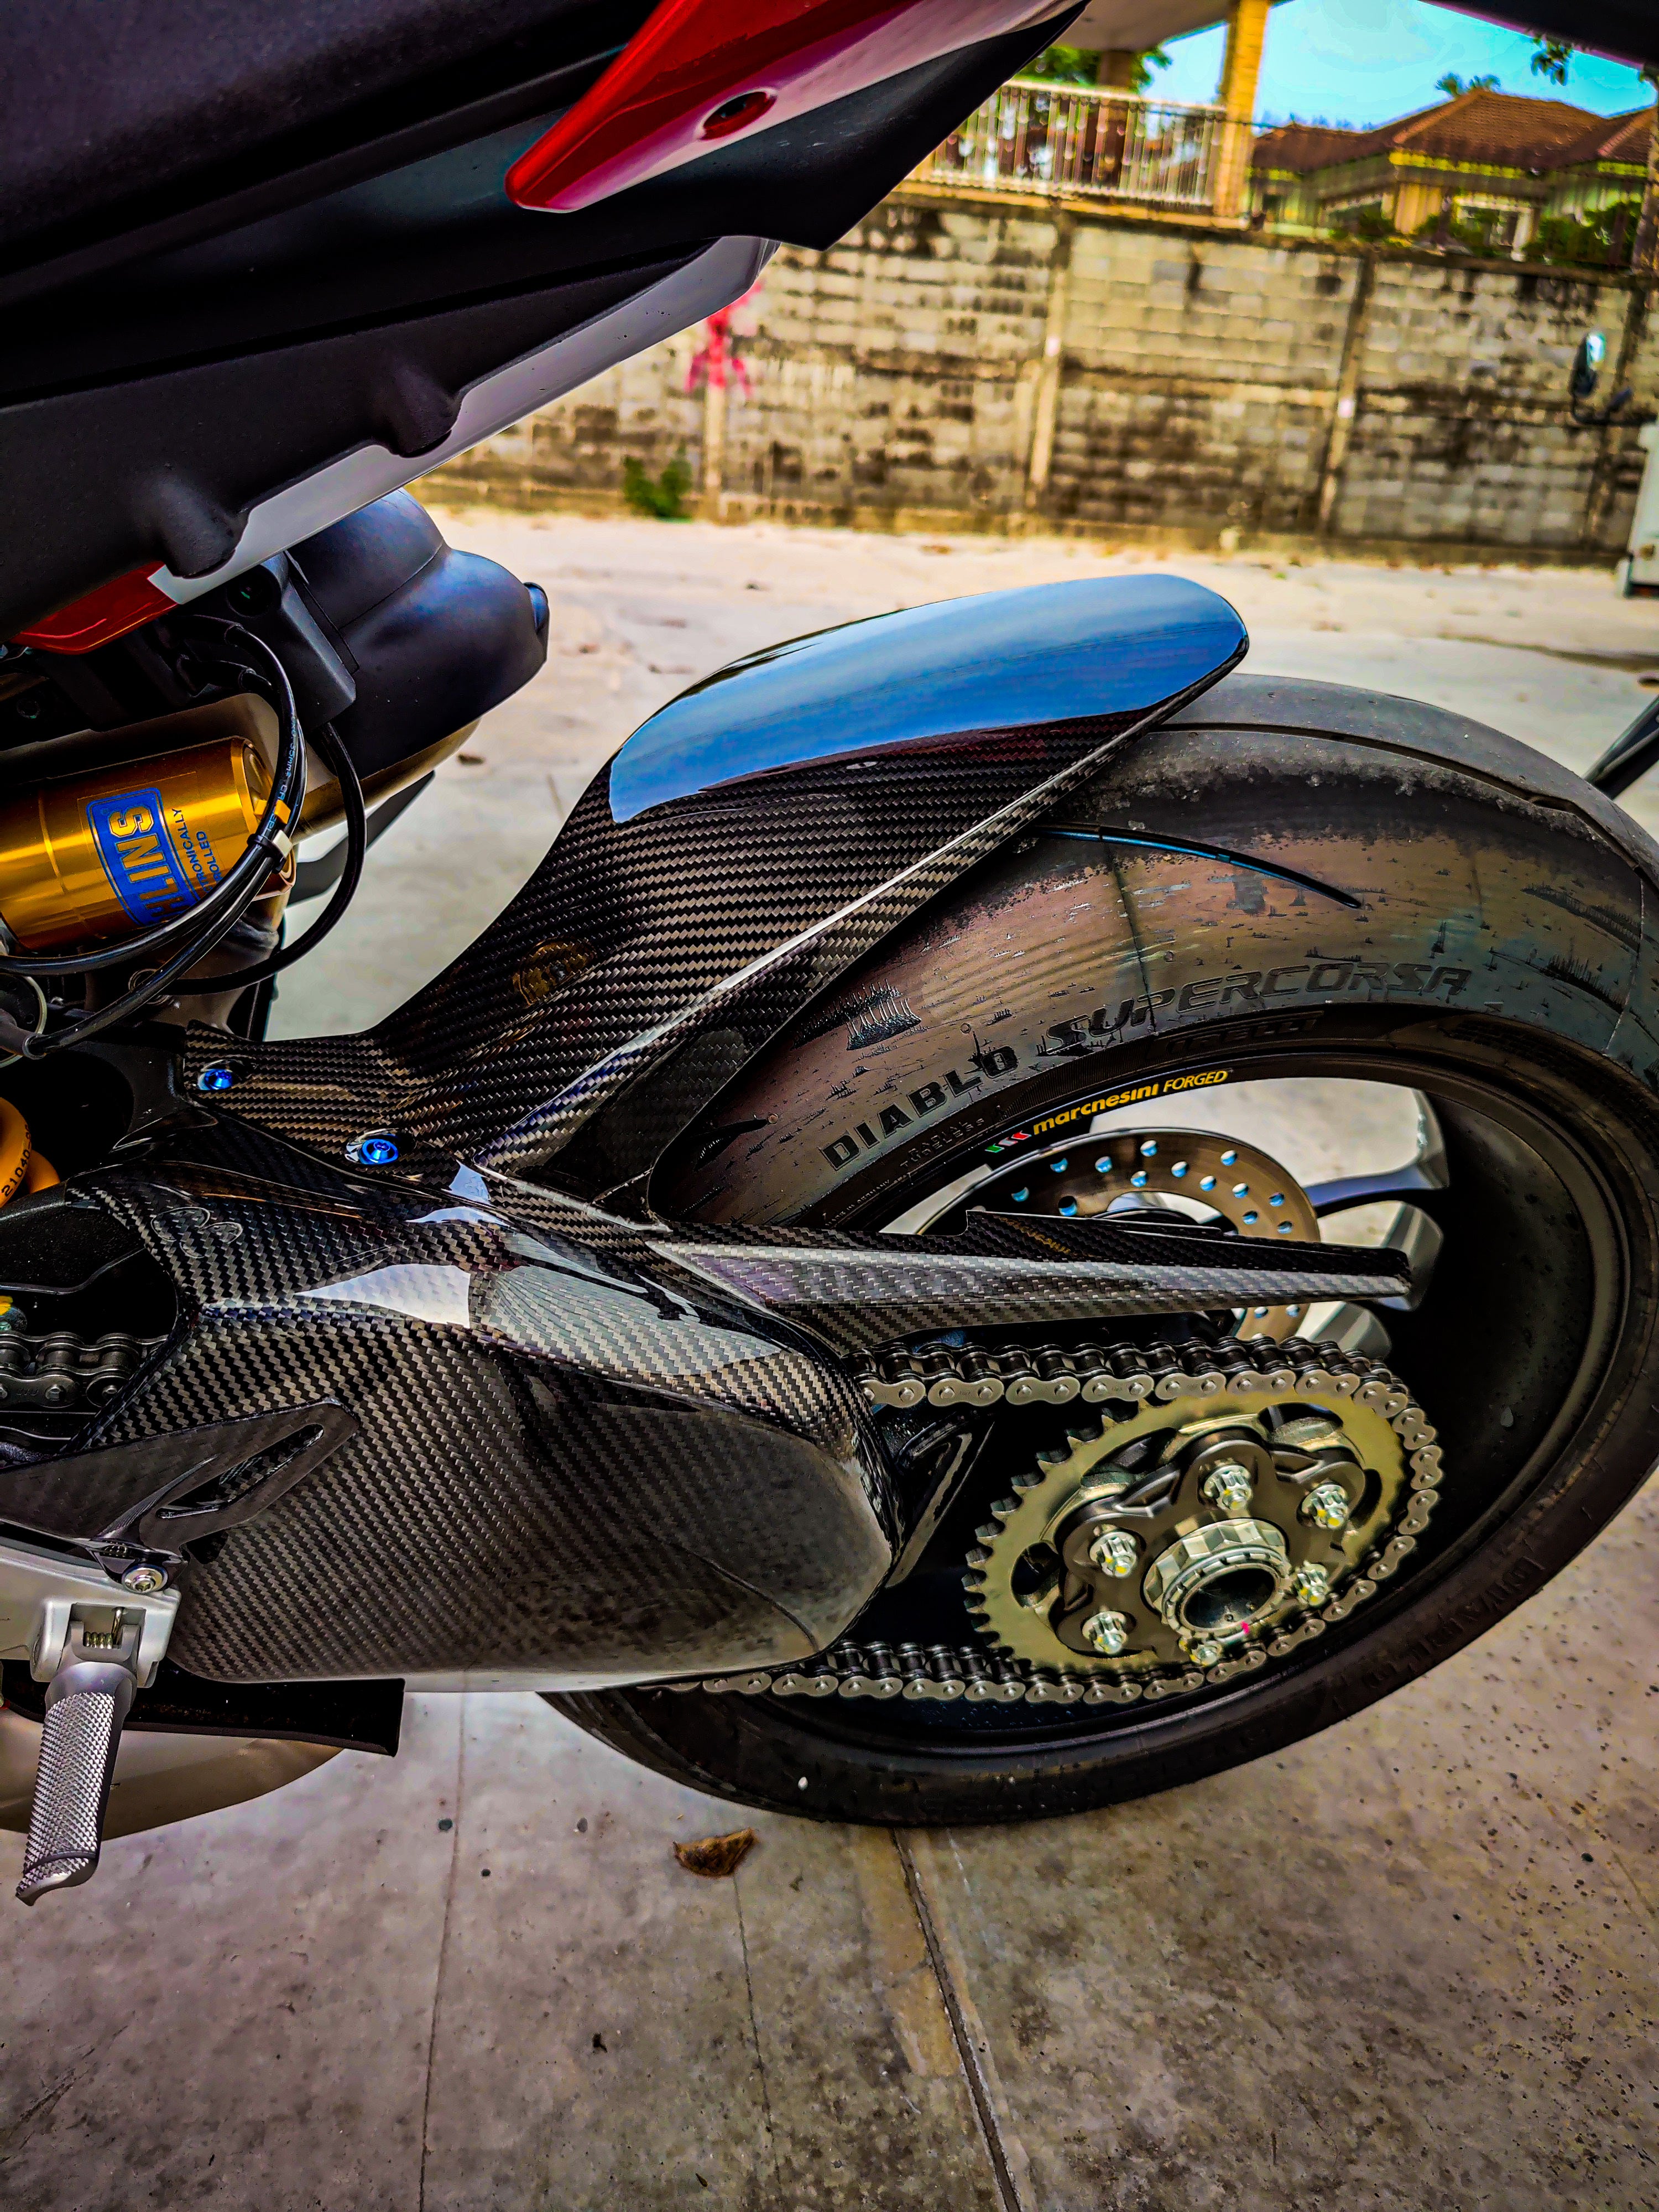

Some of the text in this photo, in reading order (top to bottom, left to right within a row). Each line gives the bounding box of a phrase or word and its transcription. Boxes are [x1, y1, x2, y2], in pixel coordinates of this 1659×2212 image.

[109, 805, 194, 921] HLINS
[818, 963, 1472, 1171] DIABLO SUPERCORSA
[1163, 1070, 1228, 1093] FORGED
